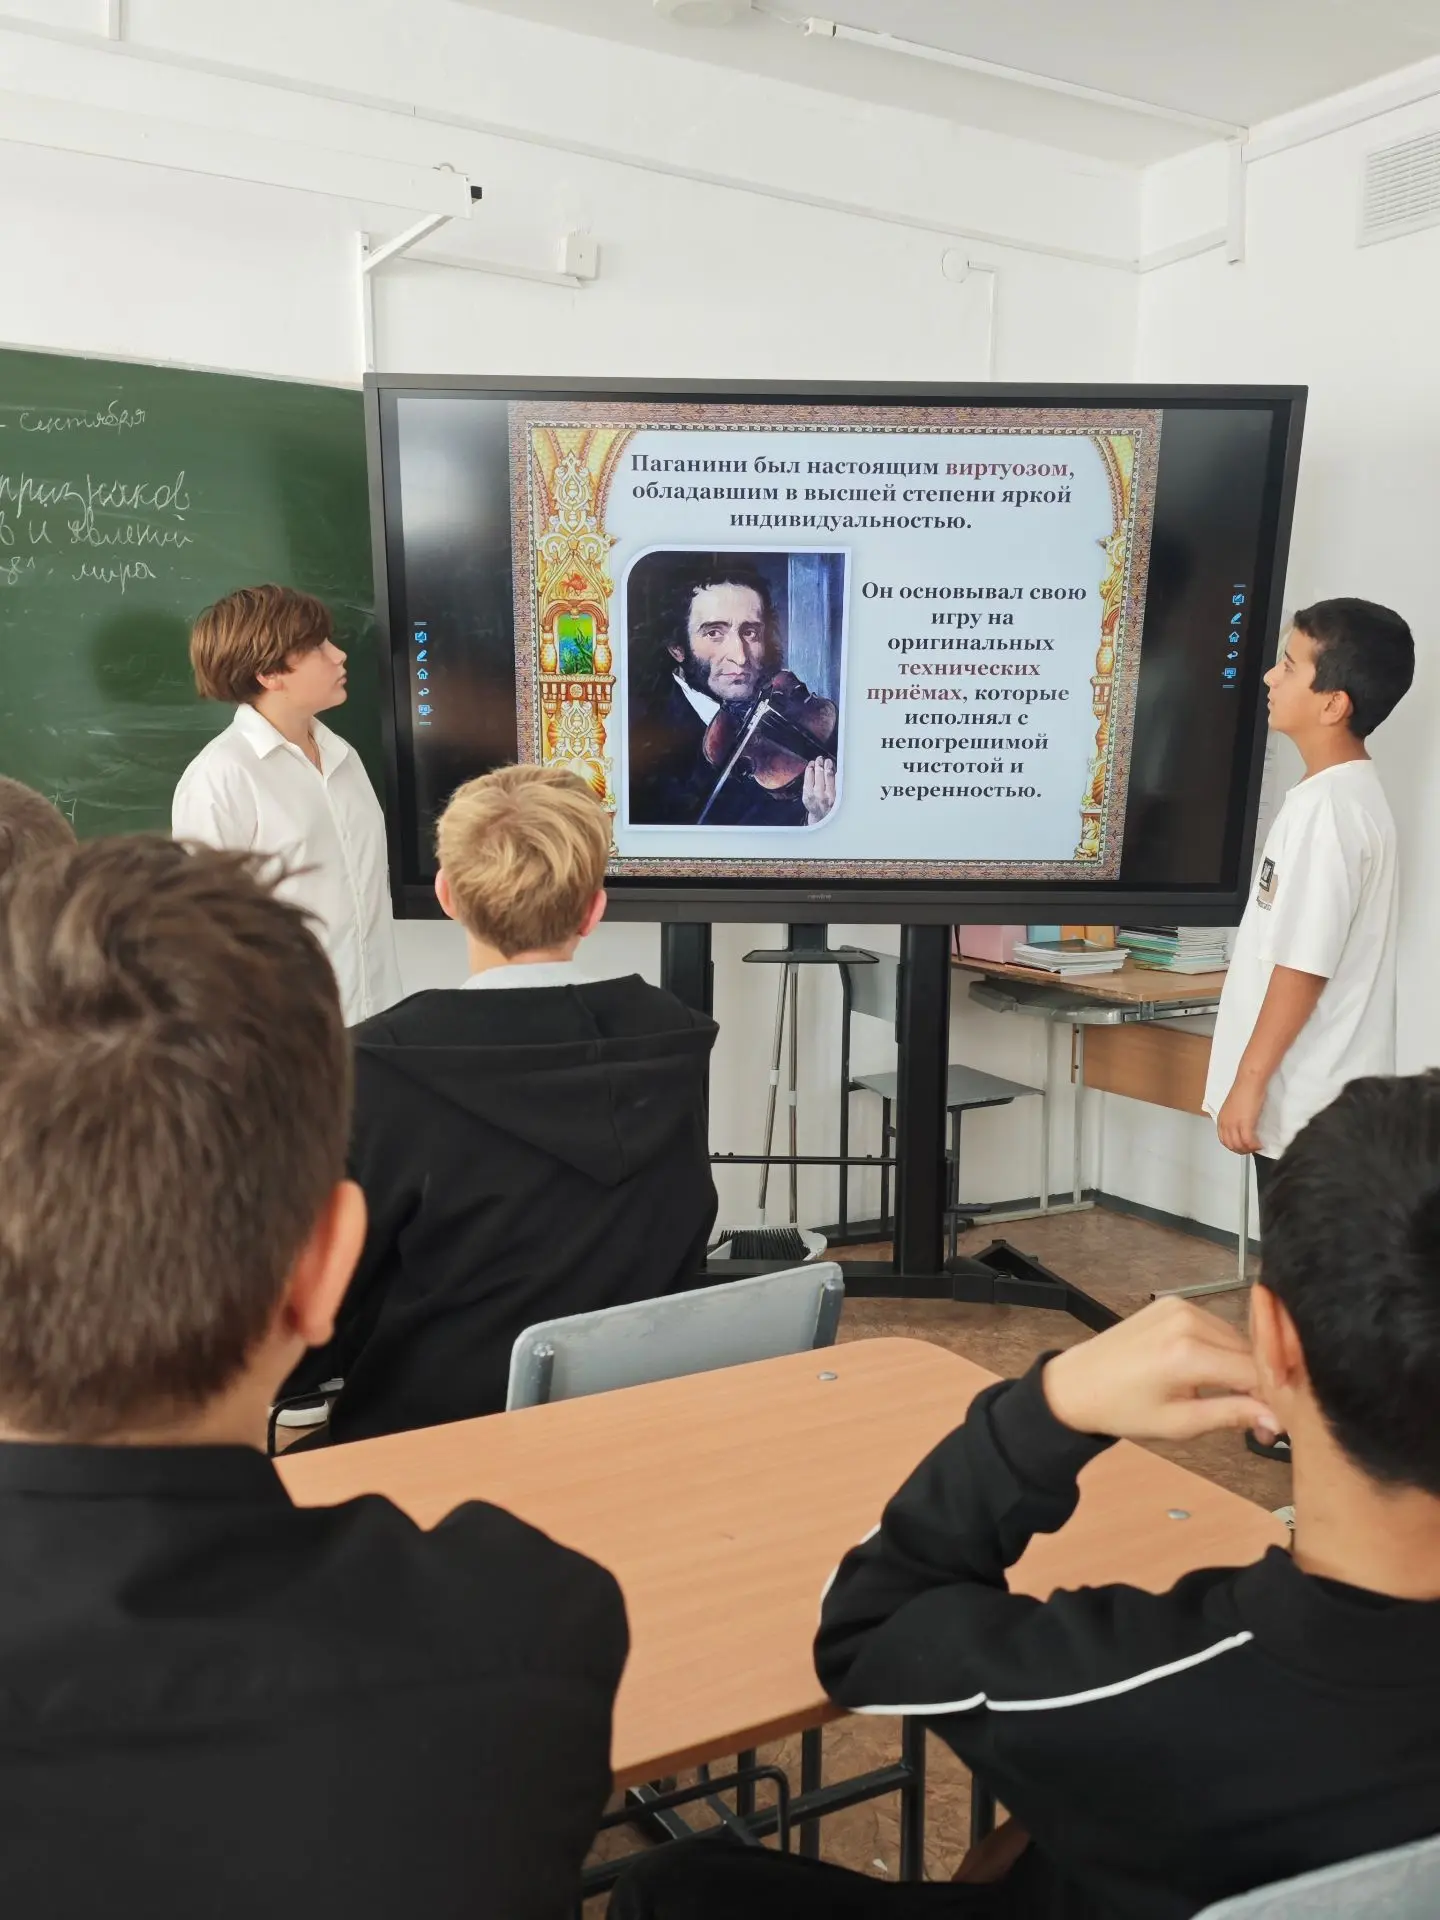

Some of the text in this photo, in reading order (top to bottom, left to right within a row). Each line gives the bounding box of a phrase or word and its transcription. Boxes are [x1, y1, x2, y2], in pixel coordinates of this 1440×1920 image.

[630, 454, 1076, 482] Паганини был настоящим виртуозом,
[631, 482, 1073, 508] обладавшим в высшей степени яркой
[729, 511, 973, 530] индивидуальностью.
[861, 581, 1087, 601] Он основывал свою
[930, 612, 1014, 629] игру на
[887, 636, 1055, 655] оригинальных
[898, 662, 1041, 676] технических
[866, 684, 1070, 705] приёмах, которые
[904, 712, 1029, 726] исполнял с
[880, 733, 1049, 753] непогрешимой
[902, 757, 1023, 774] чистотой и
[880, 784, 1042, 801] уверенностью.
